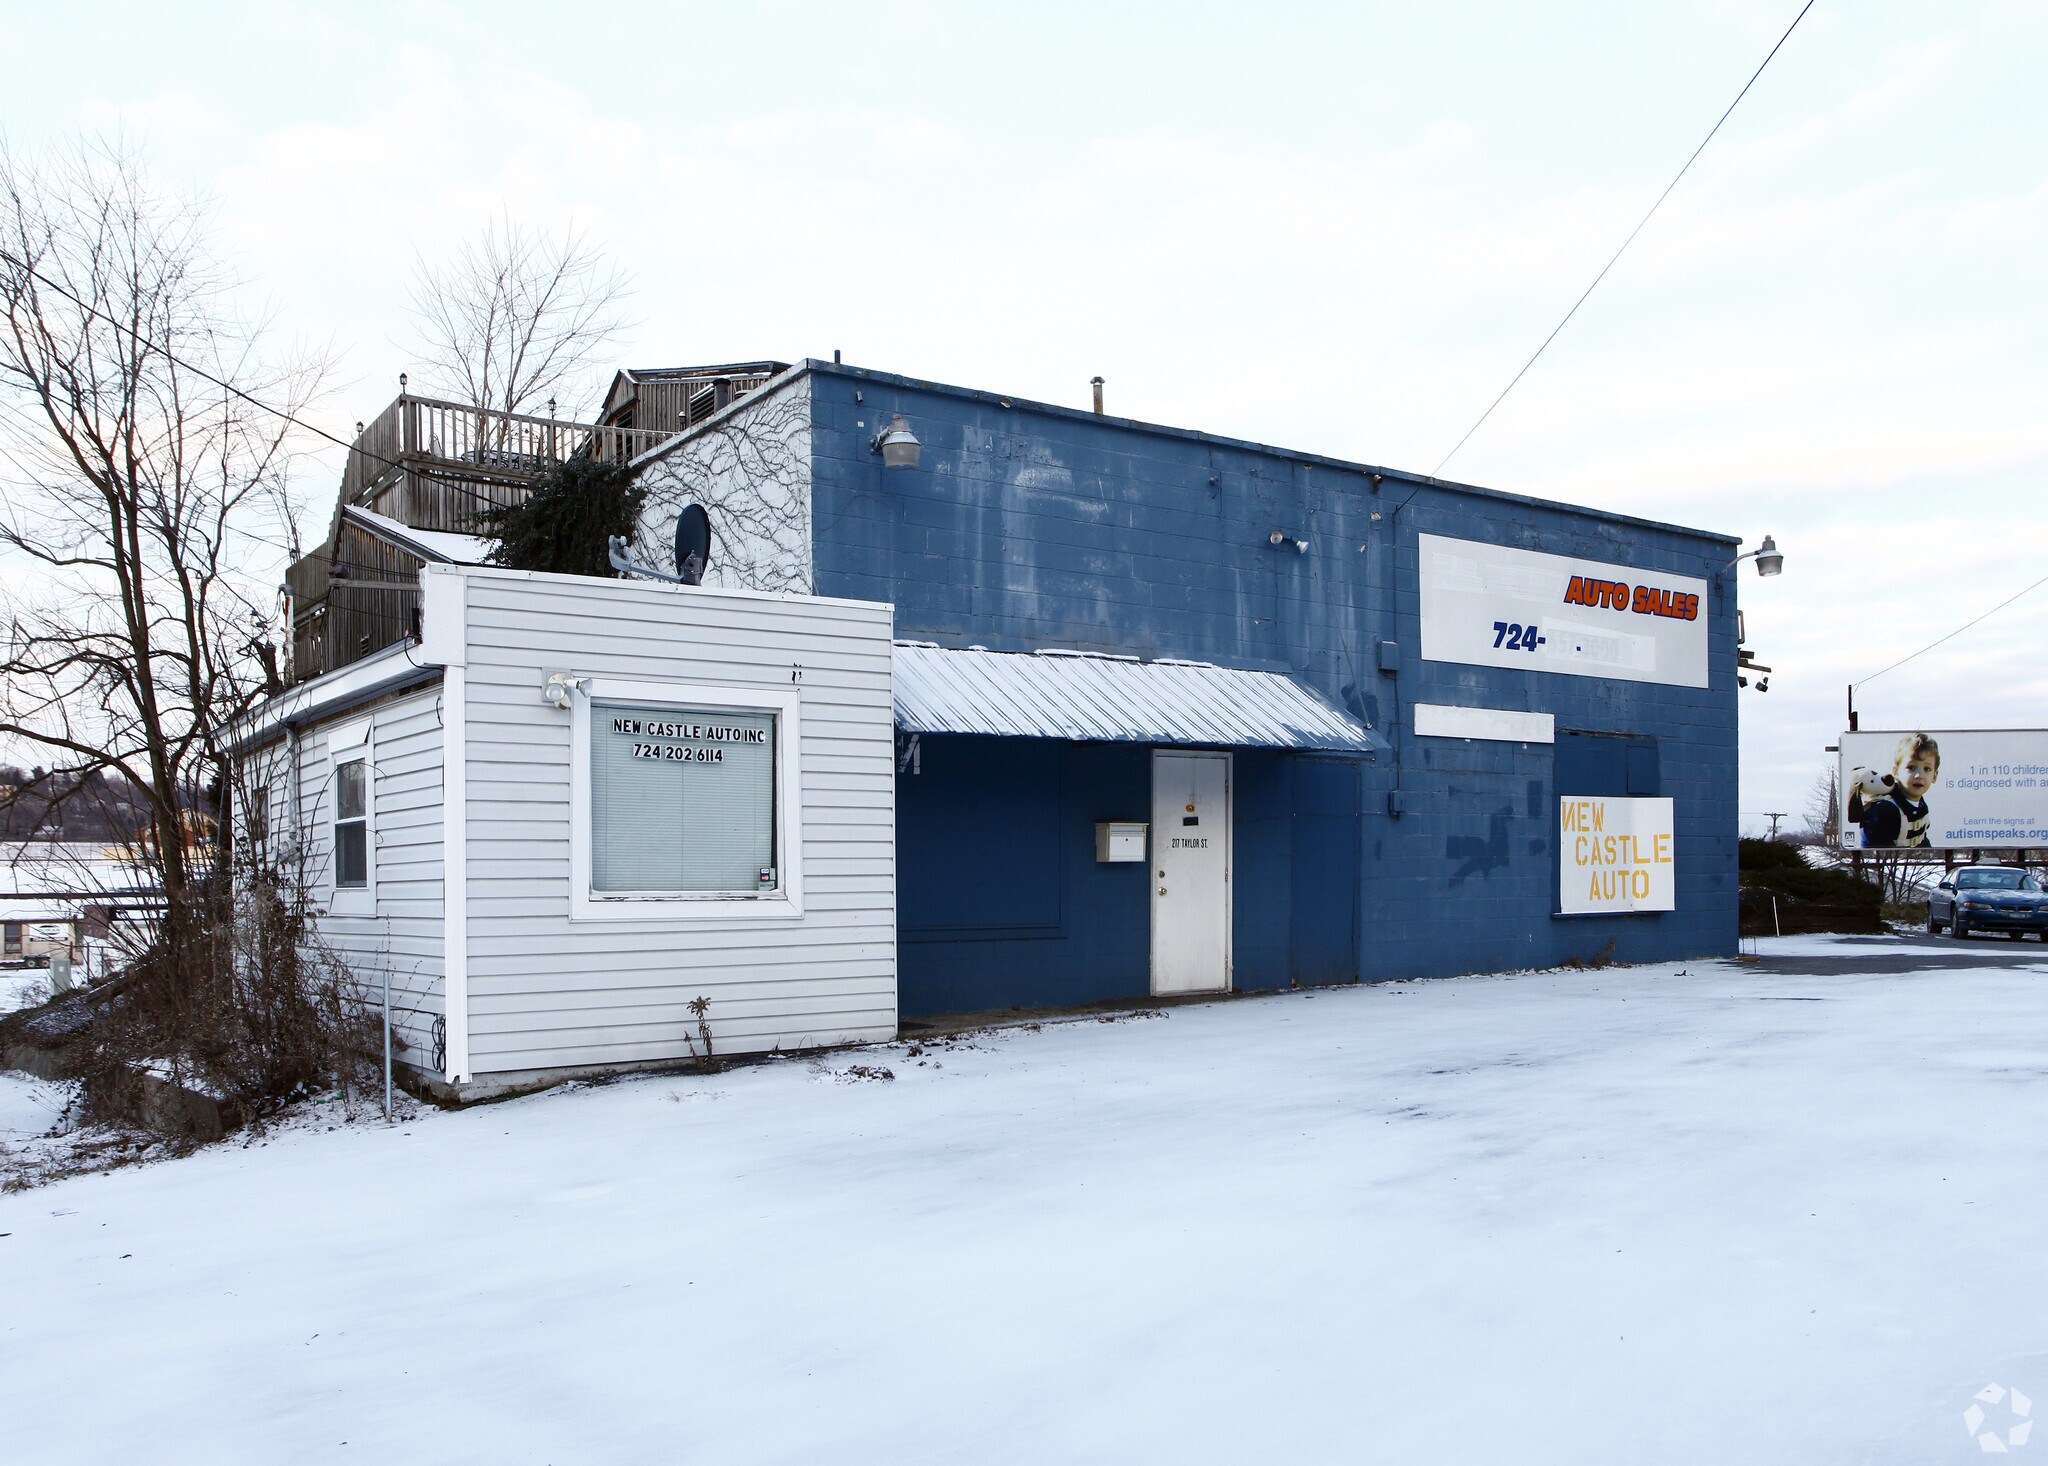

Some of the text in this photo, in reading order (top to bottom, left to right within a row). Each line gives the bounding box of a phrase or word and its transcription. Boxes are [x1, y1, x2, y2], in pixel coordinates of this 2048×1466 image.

[1563, 575, 1699, 621] AUTO SALES
[1492, 621, 1546, 652] 724-
[613, 718, 765, 743] NEW CASTLE AUTO INC
[634, 743, 723, 762] 724 202 6114
[1970, 765, 1975, 775] 1
[1979, 765, 1988, 775] in
[1993, 765, 2010, 775] 110
[1945, 778, 1954, 788] is
[1957, 778, 2012, 790] diagnosed
[2015, 778, 2036, 788] with
[1562, 802, 1604, 832] NEW
[1963, 817, 2035, 827] Learn the signs at
[1171, 838, 1209, 849] 217 TAYLOR ST.
[1945, 828, 2048, 840] autismspeaks.org
[1575, 834, 1672, 866] CASTLE
[1589, 869, 1650, 901] AUTO
